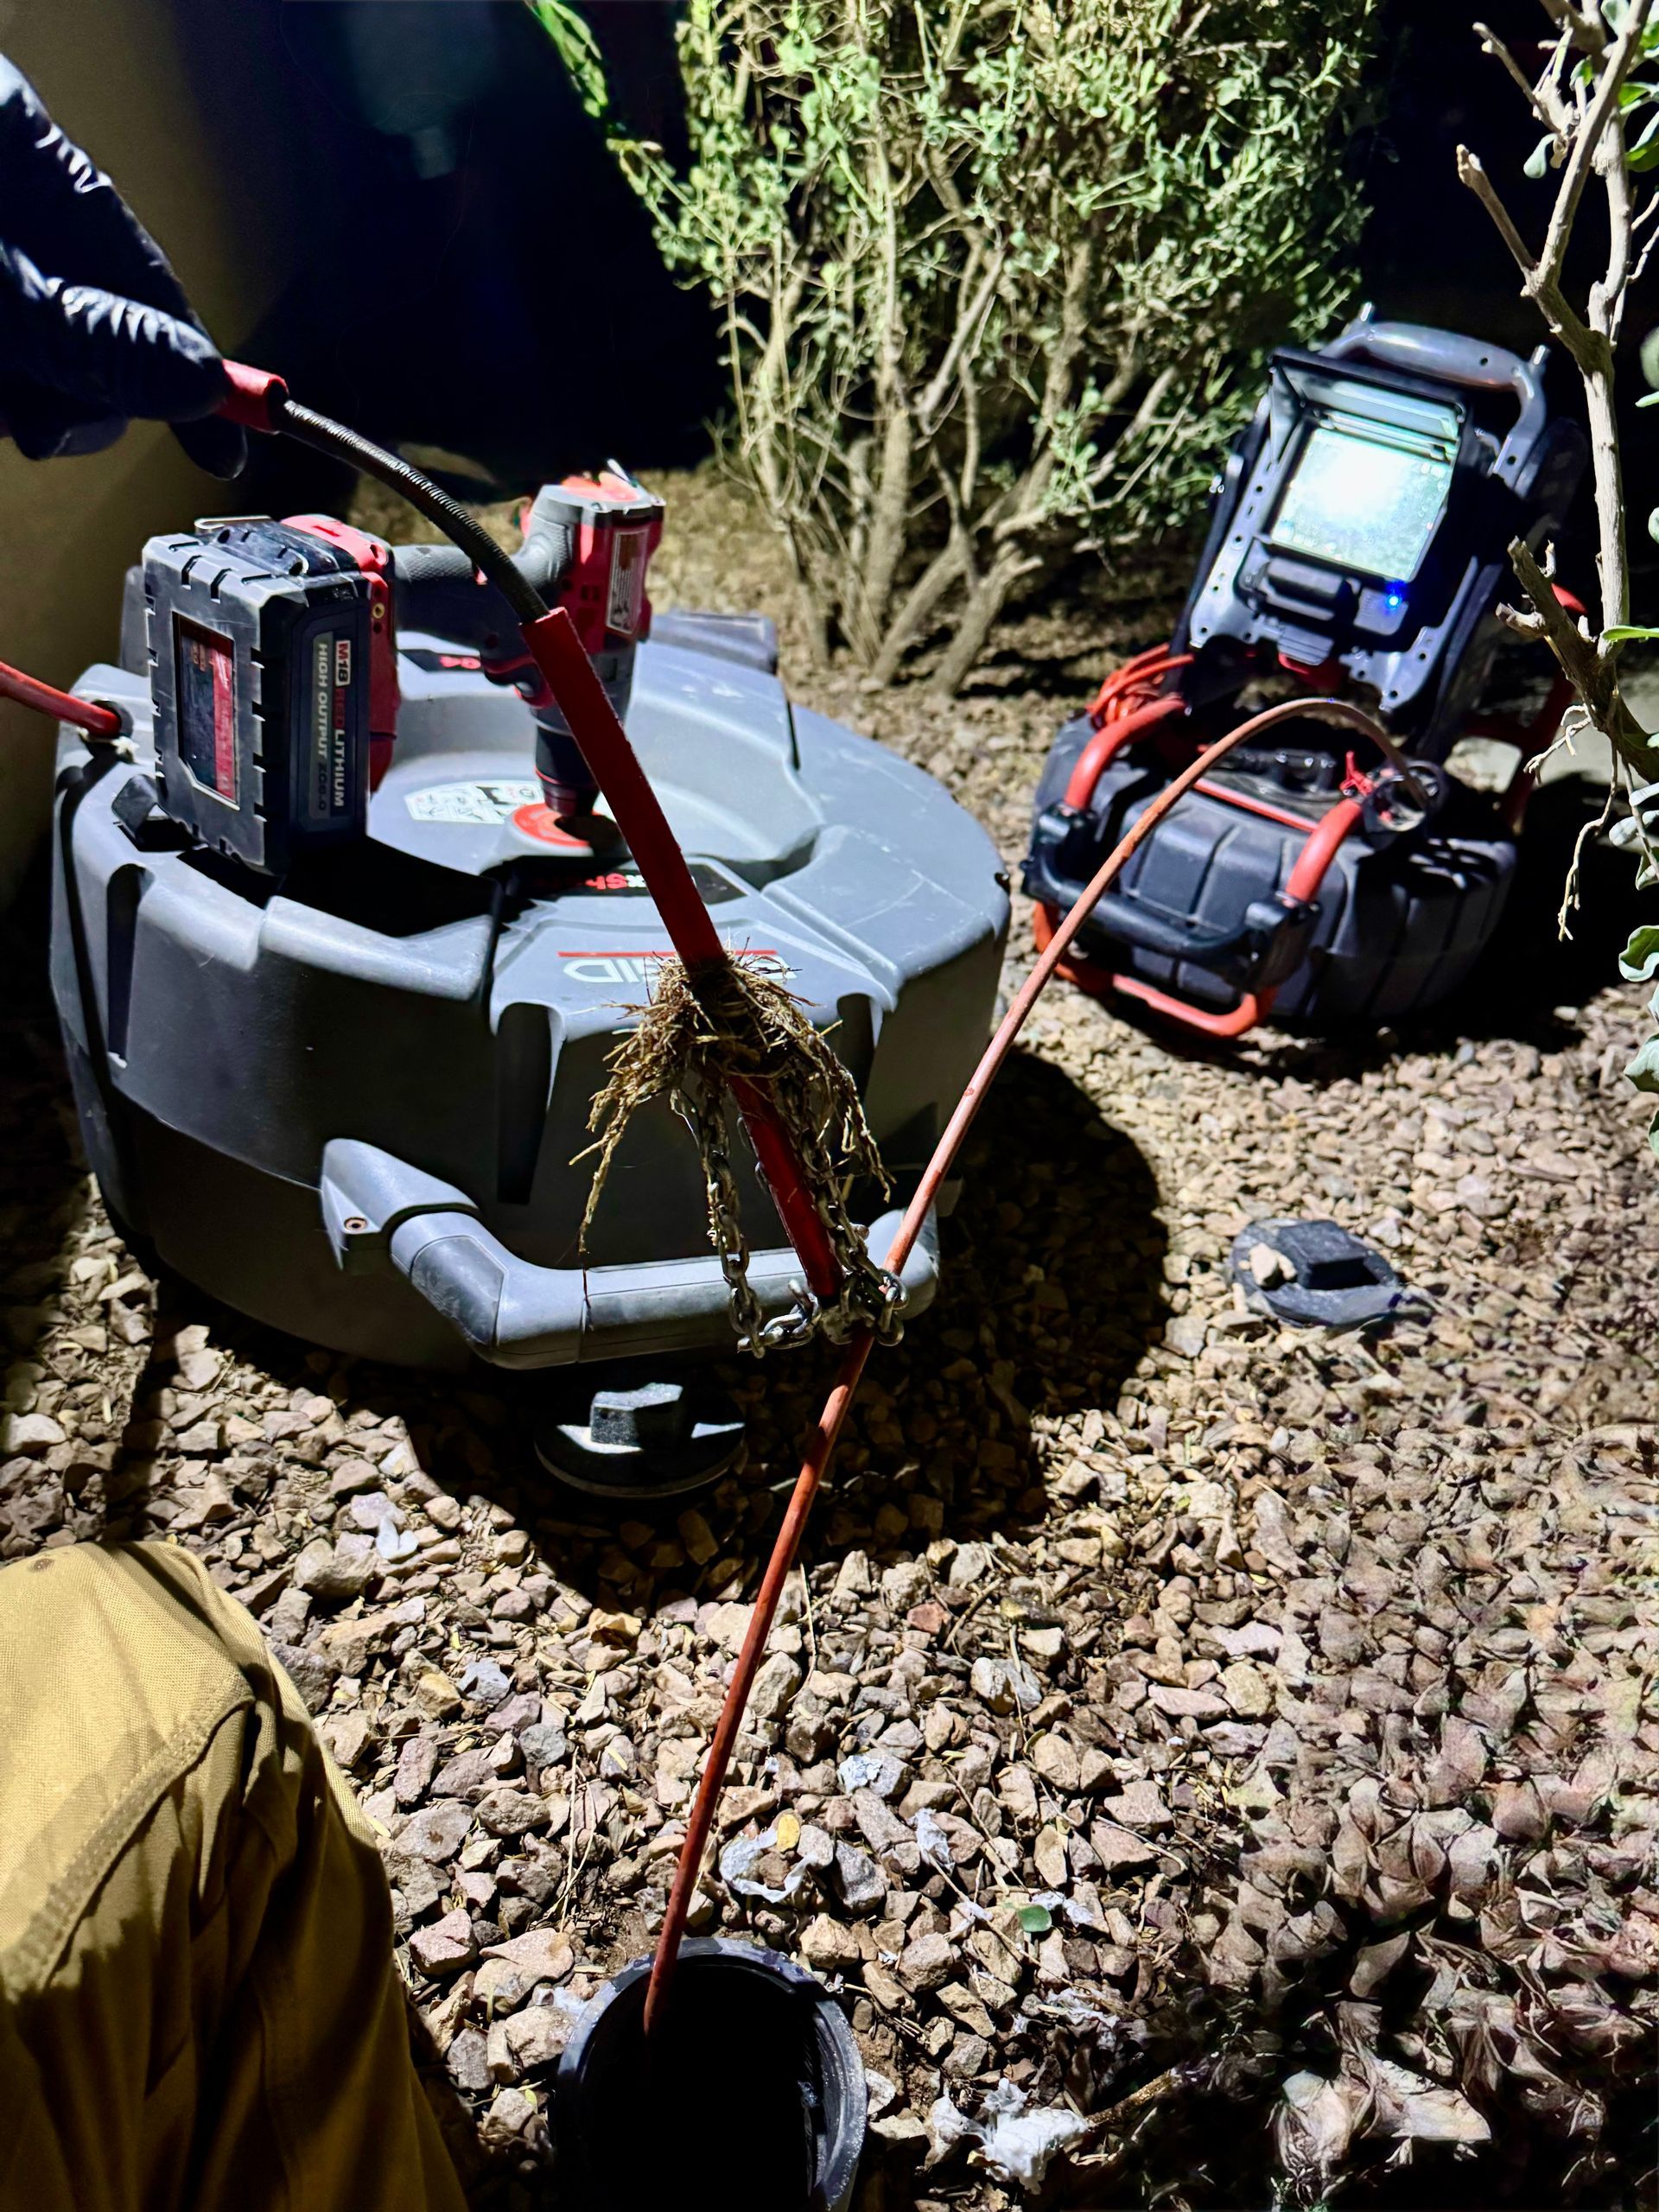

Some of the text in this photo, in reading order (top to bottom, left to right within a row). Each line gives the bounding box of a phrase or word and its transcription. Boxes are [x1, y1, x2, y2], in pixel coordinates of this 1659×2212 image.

[317, 643, 329, 688] HIGH
[337, 641, 350, 683] M18
[316, 691, 329, 759] OUTPUT
